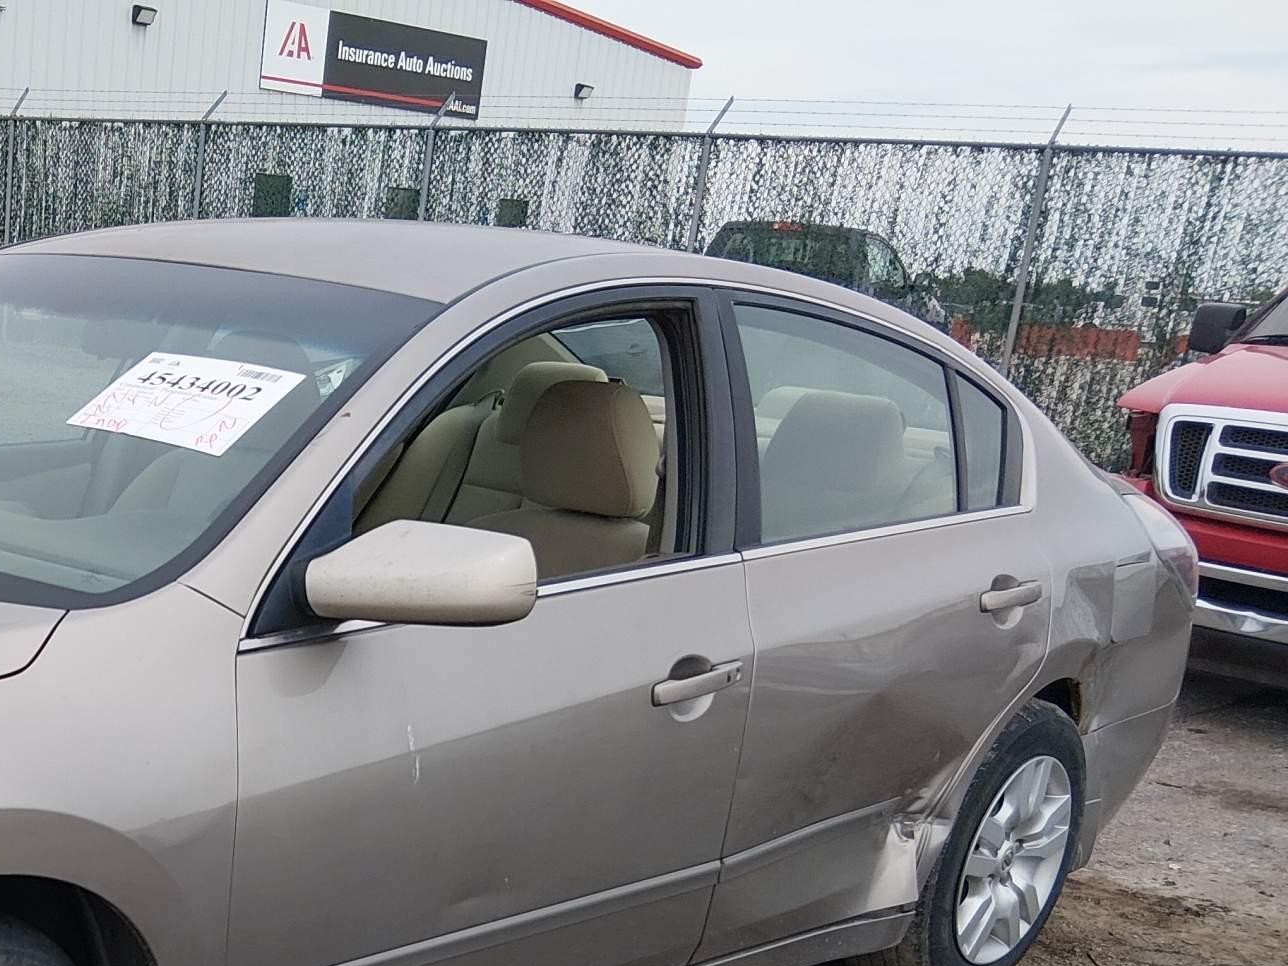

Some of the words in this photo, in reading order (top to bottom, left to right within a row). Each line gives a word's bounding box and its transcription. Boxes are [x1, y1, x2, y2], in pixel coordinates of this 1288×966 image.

[337, 40, 395, 69] Insurance
[397, 51, 424, 74] Auto
[425, 56, 473, 82] Auctions
[137, 371, 263, 401] 45434002
